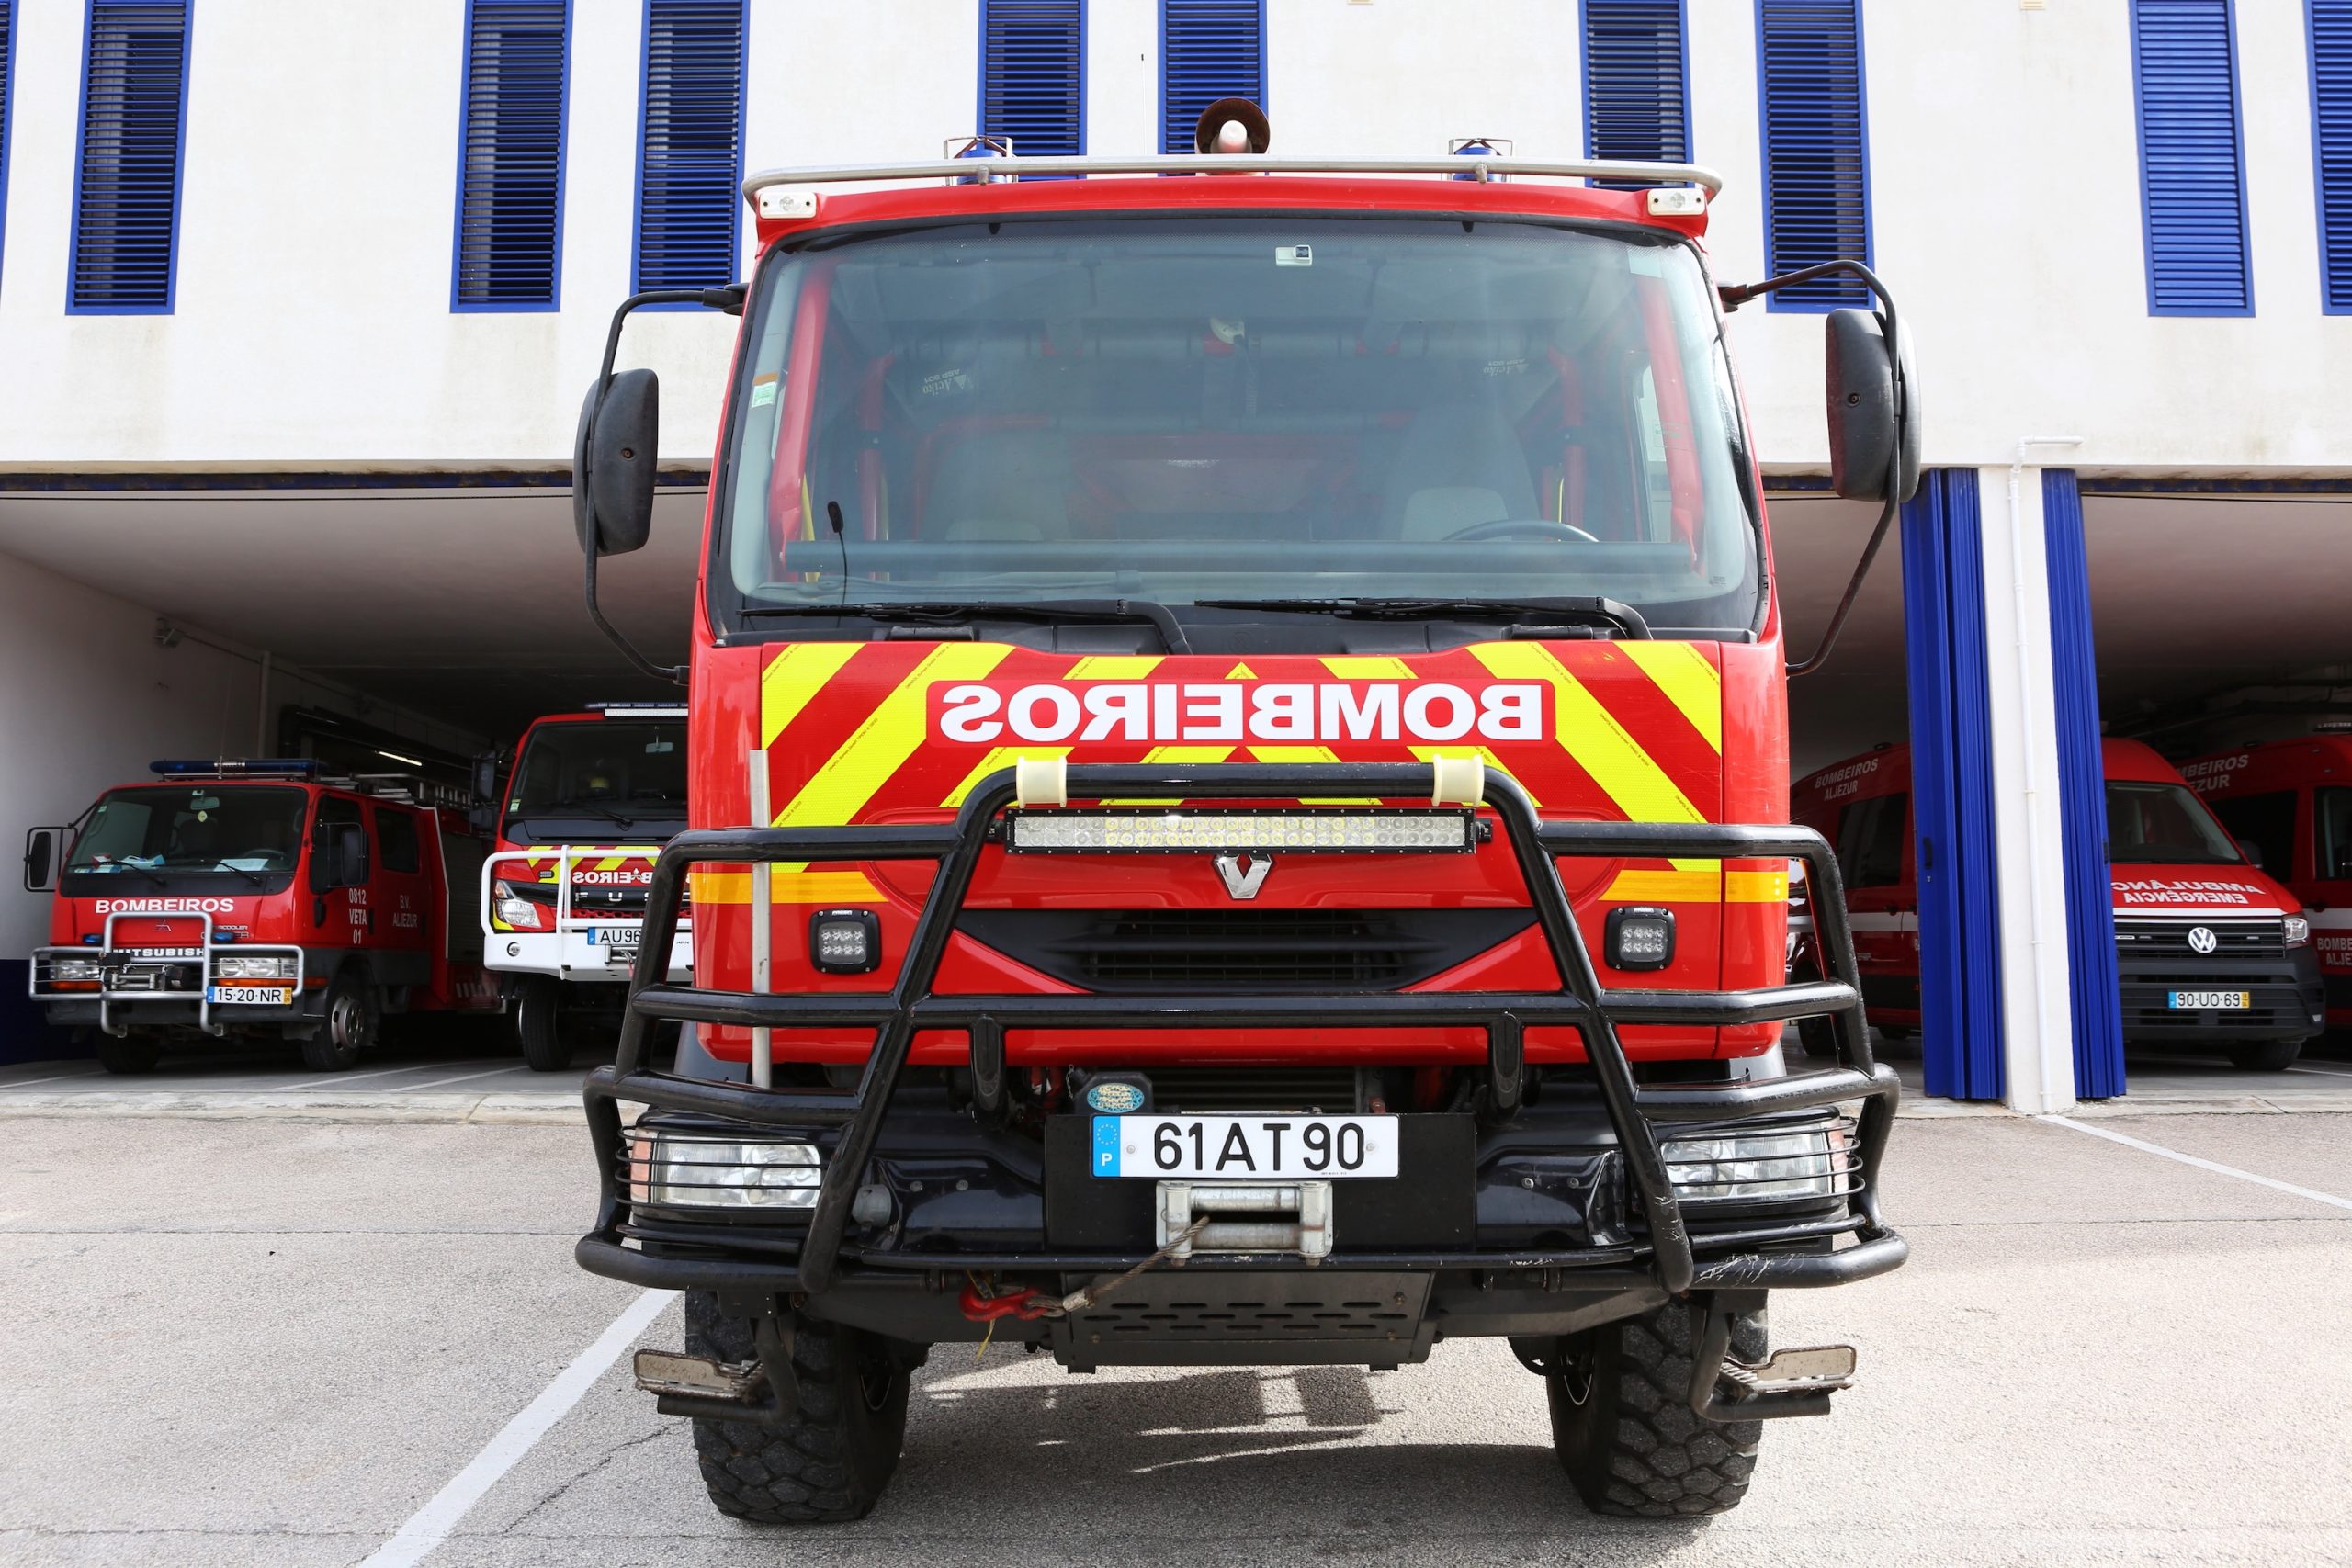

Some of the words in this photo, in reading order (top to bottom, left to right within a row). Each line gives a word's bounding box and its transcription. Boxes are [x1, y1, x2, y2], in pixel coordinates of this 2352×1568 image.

[1815, 758, 1879, 789] BOMBEIROS
[2175, 754, 2249, 780] MBEIROS
[1824, 780, 1859, 801] ALJEZUR
[348, 887, 367, 905] 0812
[95, 898, 234, 914] BOMBEIROS
[348, 908, 368, 925] VETA
[392, 914, 418, 928] ALJEZUR
[353, 929, 362, 944] 01
[599, 929, 641, 943] AU96
[2317, 937, 2352, 951] BOMBE
[113, 948, 204, 957] MITSUBISH
[2326, 953, 2352, 965] ALJE
[1102, 1153, 1113, 1167] P
